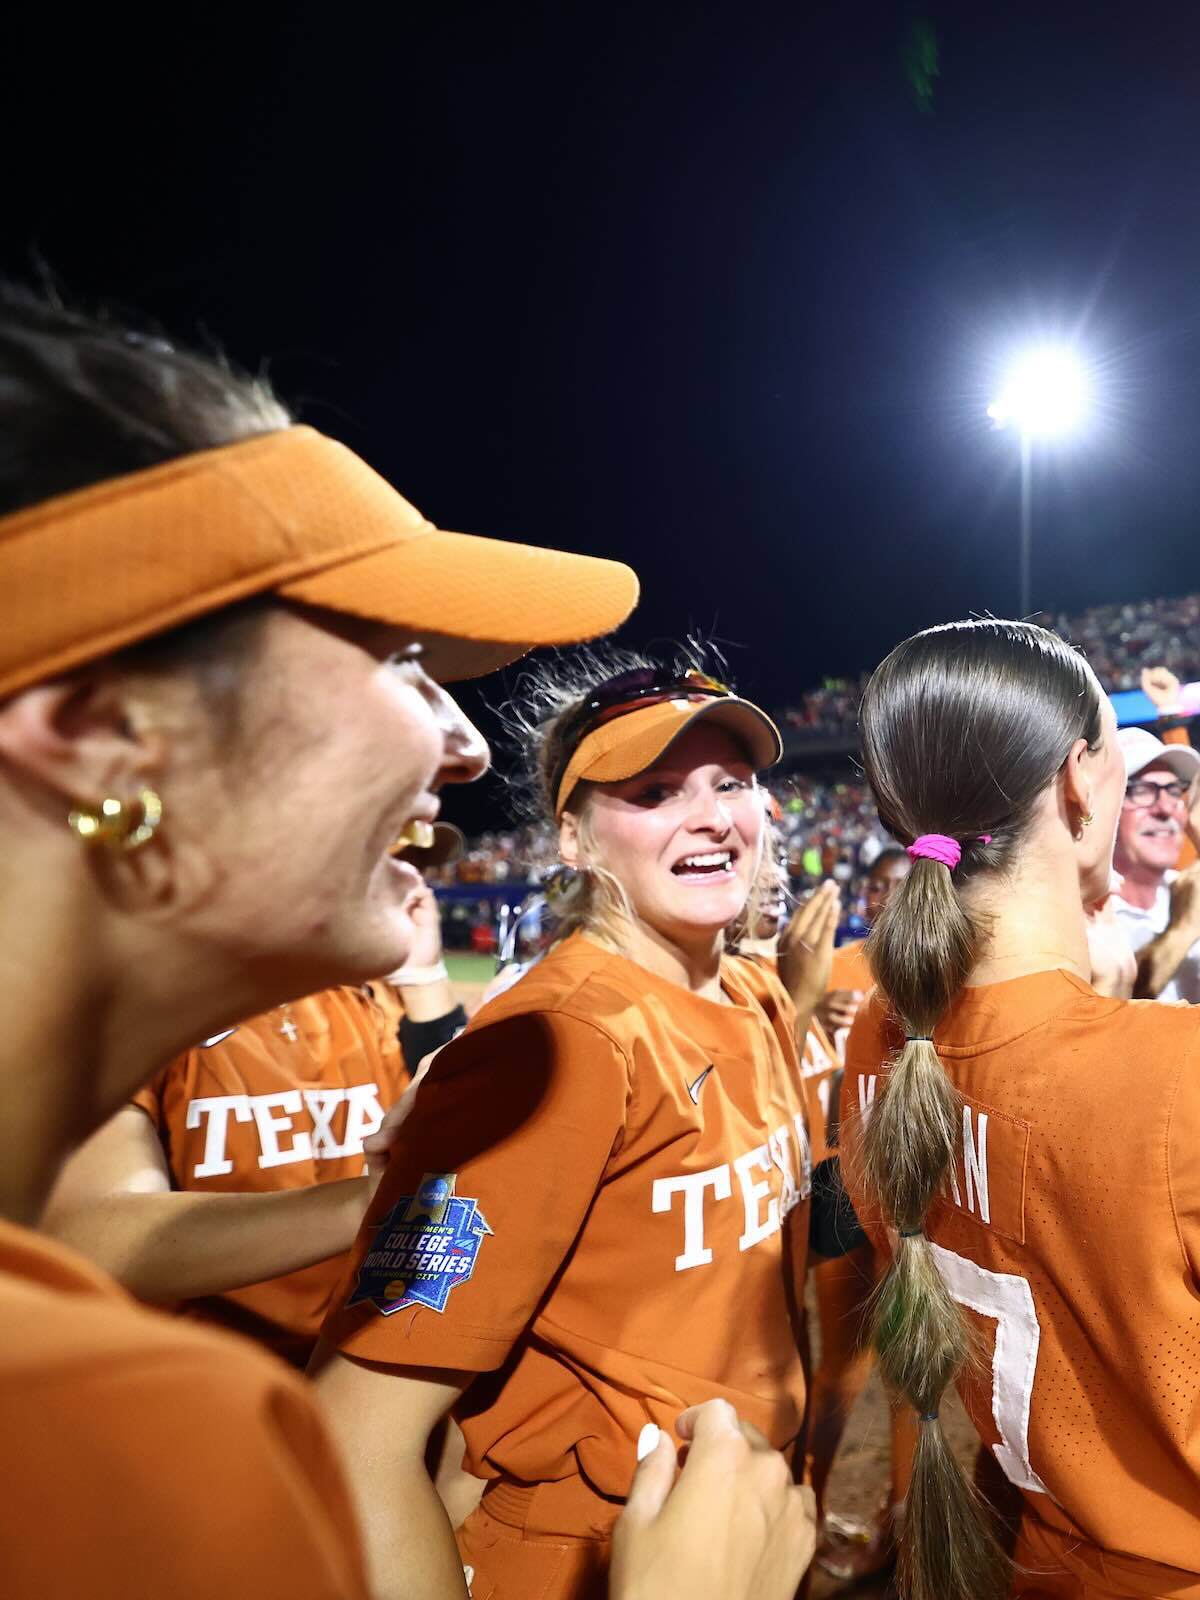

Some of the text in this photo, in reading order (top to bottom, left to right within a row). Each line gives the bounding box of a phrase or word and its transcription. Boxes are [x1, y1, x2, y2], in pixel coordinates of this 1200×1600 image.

[186, 1083, 385, 1178] TEXA
[413, 1224, 455, 1235] OMEN'S
[384, 1233, 454, 1253] COLLEGE
[404, 1253, 472, 1273] SERIES
[415, 1273, 440, 1281] CITY
